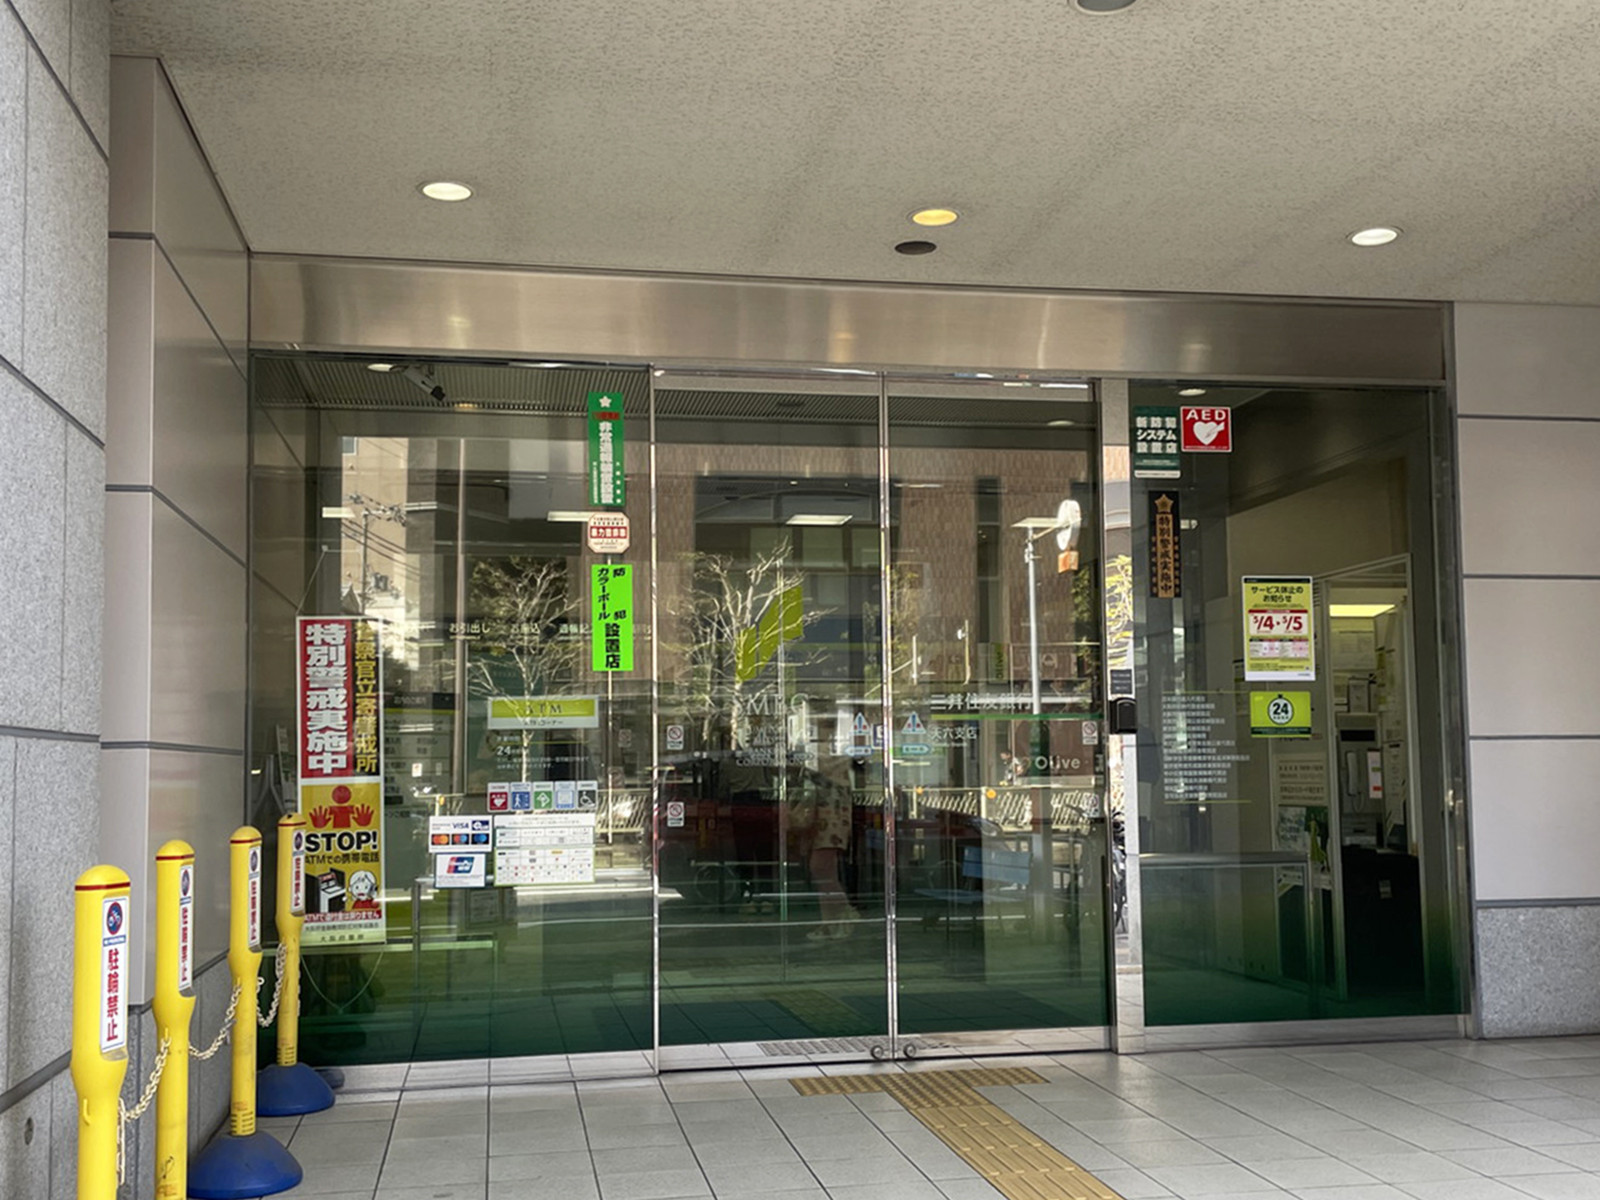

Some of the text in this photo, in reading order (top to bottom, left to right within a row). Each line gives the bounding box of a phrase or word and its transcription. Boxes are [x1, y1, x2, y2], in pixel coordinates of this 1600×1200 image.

[1186, 409, 1226, 420] AED
[1136, 429, 1177, 441] システム
[598, 567, 610, 621] カラーボール
[1251, 586, 1304, 595] サービス休止の
[1263, 595, 1292, 603] お知らせ
[605, 623, 620, 669] 設置店
[305, 623, 348, 775] 特別警戒実施中
[930, 692, 1034, 711] 三井住友銀行
[1273, 702, 1289, 715] 24
[930, 726, 978, 740] 天六支店
[1034, 755, 1081, 770] Olive
[305, 830, 378, 852] STOP!
